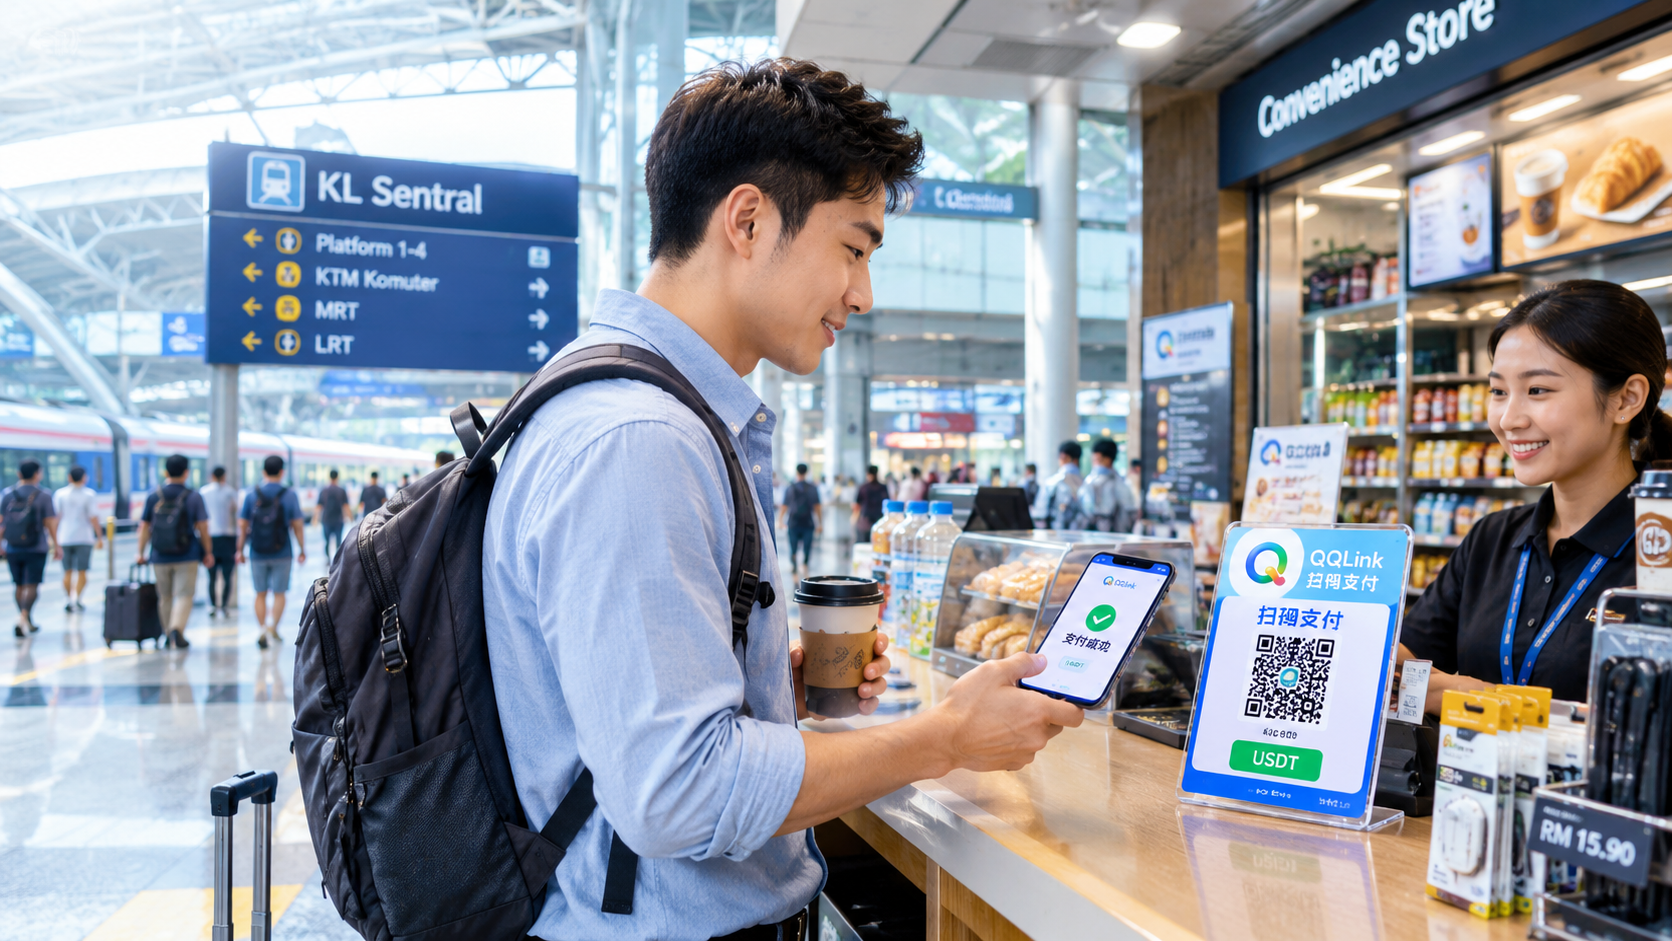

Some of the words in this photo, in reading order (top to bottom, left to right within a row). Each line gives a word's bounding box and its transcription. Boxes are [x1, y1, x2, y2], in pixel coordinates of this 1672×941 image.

[1257, 39, 1401, 138] Convenience
[1405, 0, 1496, 65] Store
[318, 170, 364, 205] KL
[371, 174, 483, 215] Sentral
[315, 233, 394, 258] Platform
[397, 240, 428, 260] 1-4
[315, 266, 360, 288] KTM
[363, 269, 440, 292] Komuter
[315, 300, 360, 321] MRT
[315, 334, 355, 355] LRT
[1310, 549, 1384, 569] QQLink
[1252, 750, 1300, 770] USDT
[1539, 818, 1574, 849] RM
[1576, 828, 1636, 868] 15.90
